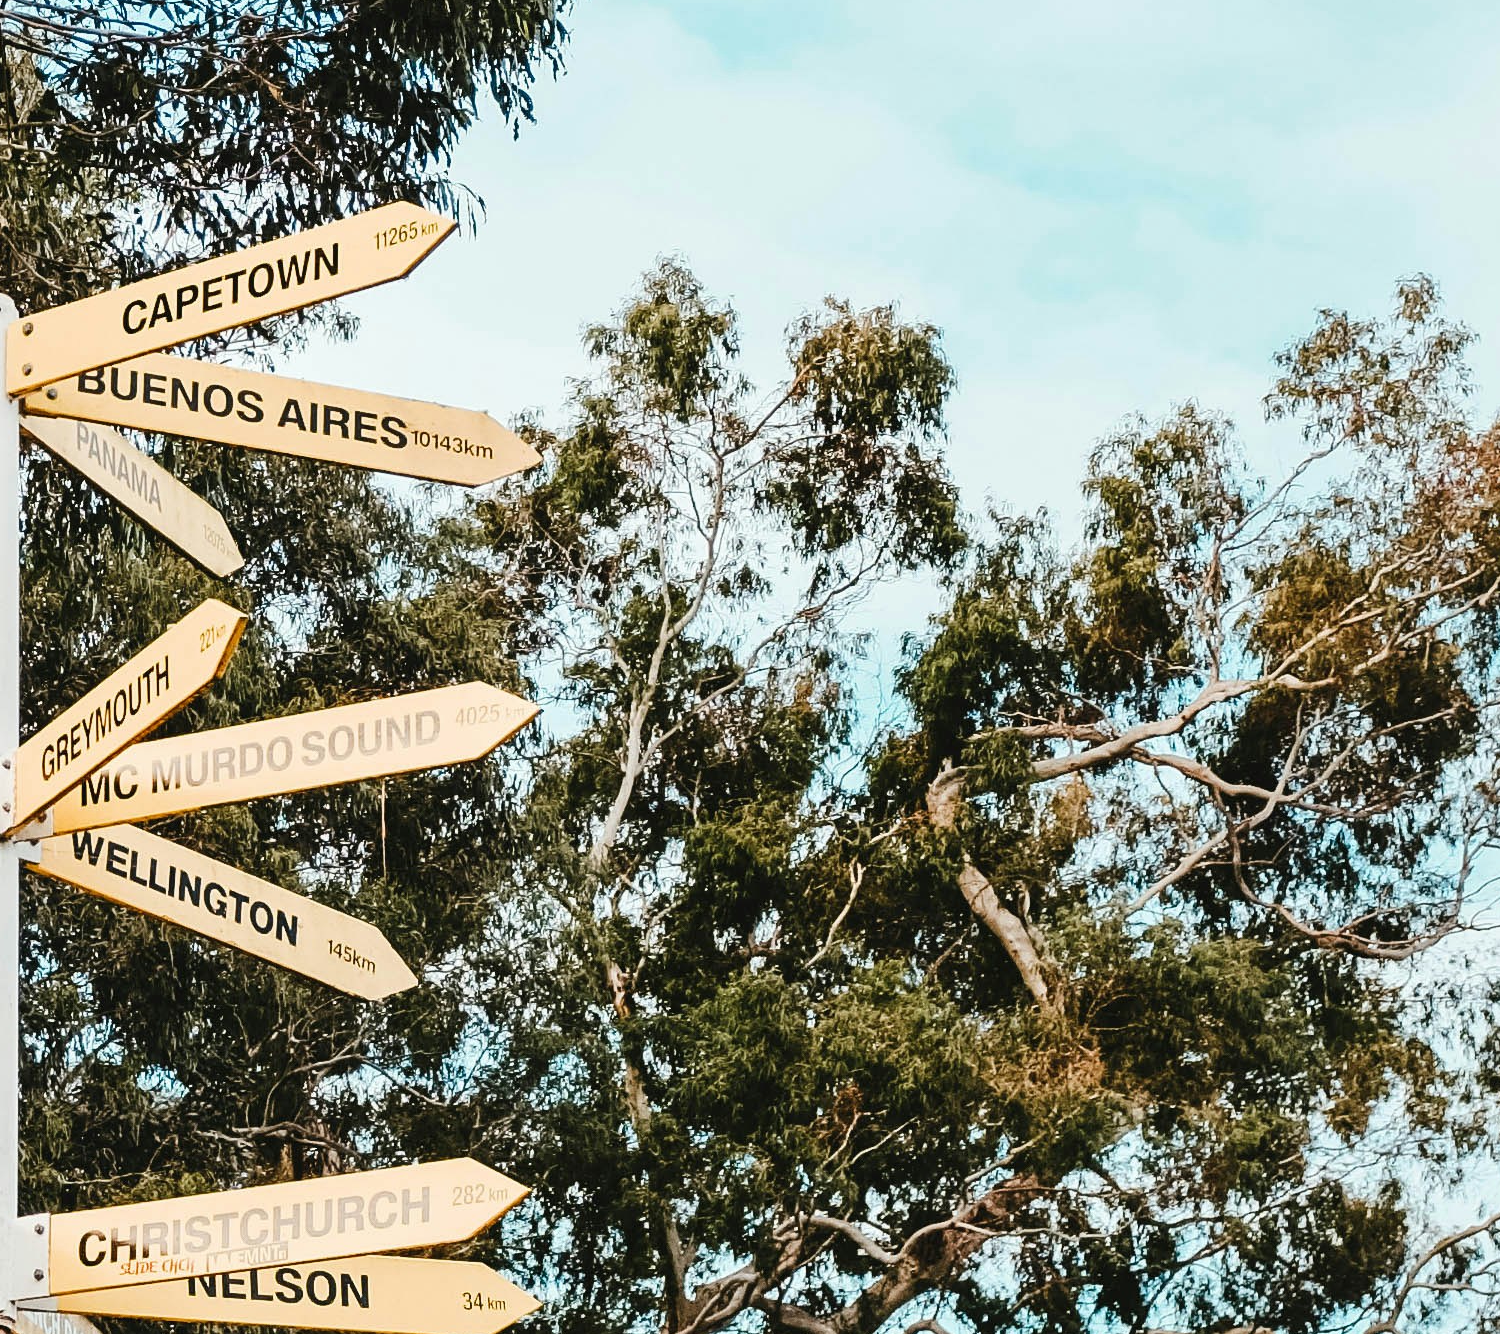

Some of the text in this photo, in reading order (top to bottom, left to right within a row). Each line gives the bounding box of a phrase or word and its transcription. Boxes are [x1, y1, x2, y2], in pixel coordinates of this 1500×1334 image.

[374, 220, 439, 251] 11265 km
[122, 242, 340, 336] CAPETOWN
[77, 366, 409, 450] BUENOS AIRES
[411, 430, 494, 460] 10143km
[76, 420, 162, 514] PANAMA
[200, 625, 215, 653] 221
[41, 655, 171, 782] GREYMOUTH
[455, 703, 502, 727] 4025
[80, 709, 442, 807] MC MURDO SOUND
[71, 830, 299, 947] WELLINGTON
[327, 938, 377, 974] 145km
[452, 1183, 509, 1207] 282 km
[78, 1185, 431, 1268] CHRISTCHURCH
[187, 1267, 371, 1310] NELSON
[462, 1290, 507, 1312] 34 km
